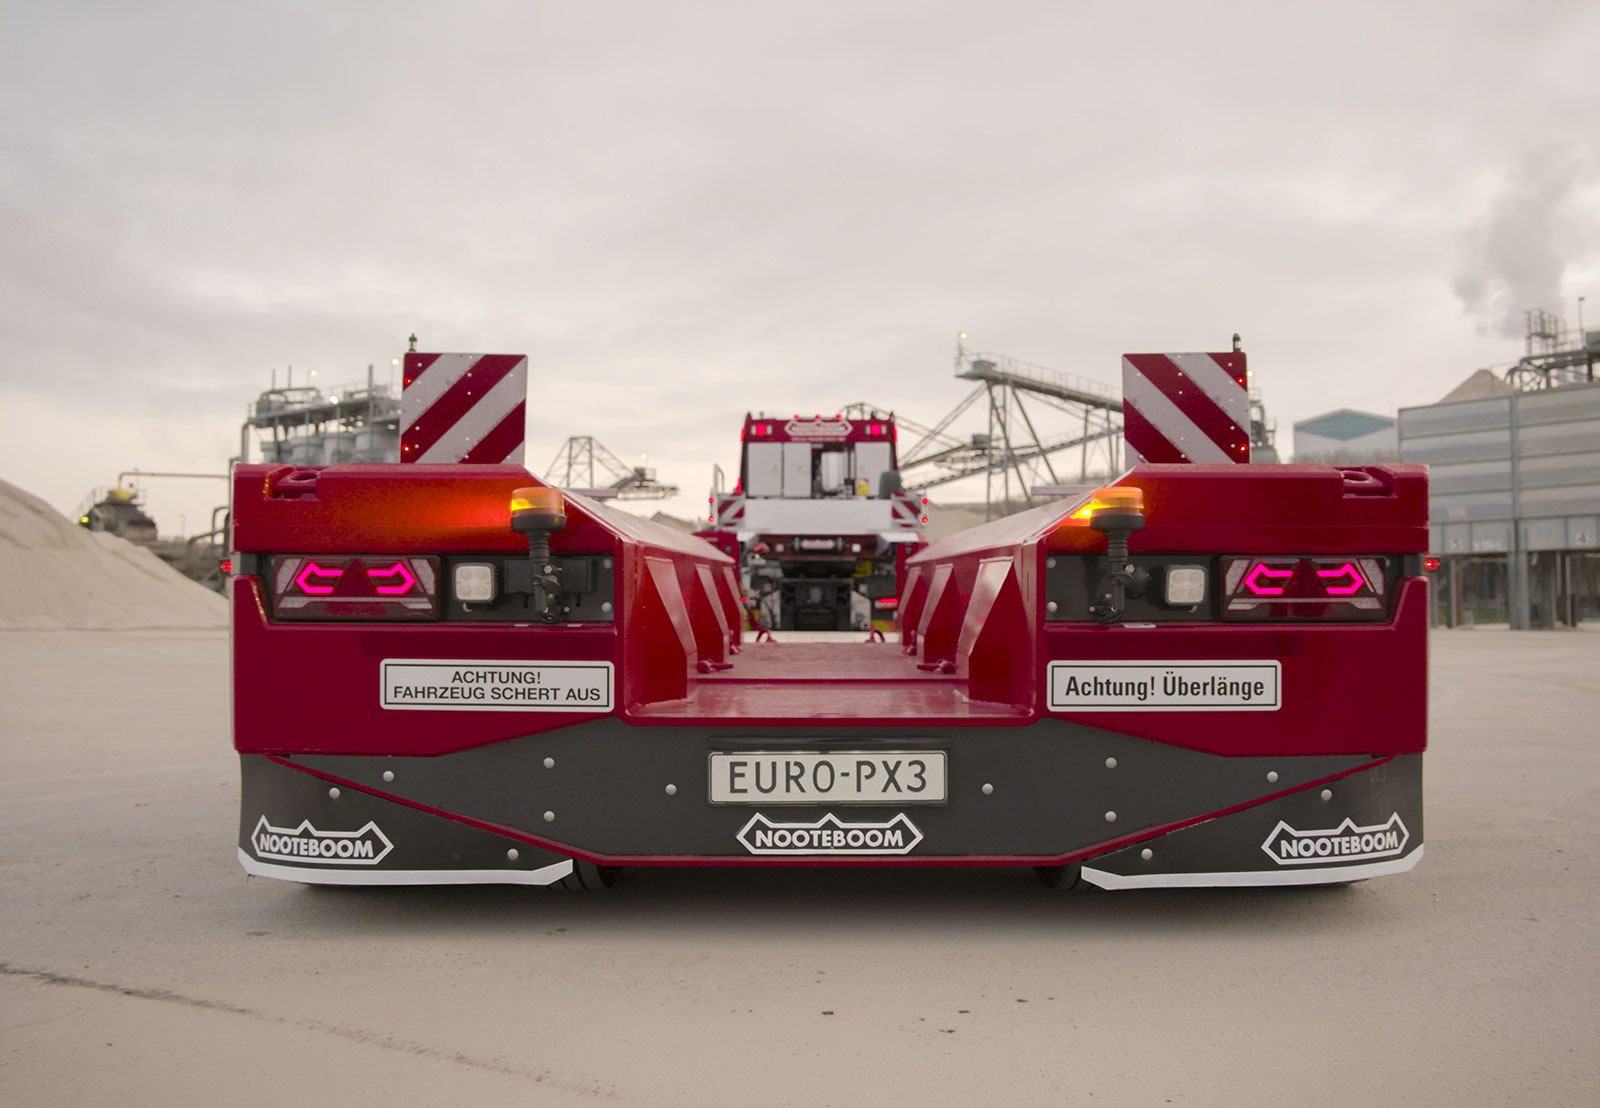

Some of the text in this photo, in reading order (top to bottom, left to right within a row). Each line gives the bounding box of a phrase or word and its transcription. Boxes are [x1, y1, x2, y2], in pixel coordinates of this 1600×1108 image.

[451, 670, 541, 684] ACHTUNG!
[1065, 671, 1265, 701] Achtung! Überlänge
[393, 686, 601, 701] FAHRZEUG SCHERT AUS
[729, 760, 926, 793] EURO-PX3
[260, 833, 374, 858] NOOTEBOOM
[755, 829, 904, 848] NOOTEBOOM
[1280, 832, 1398, 857] NOOTEBOOM
